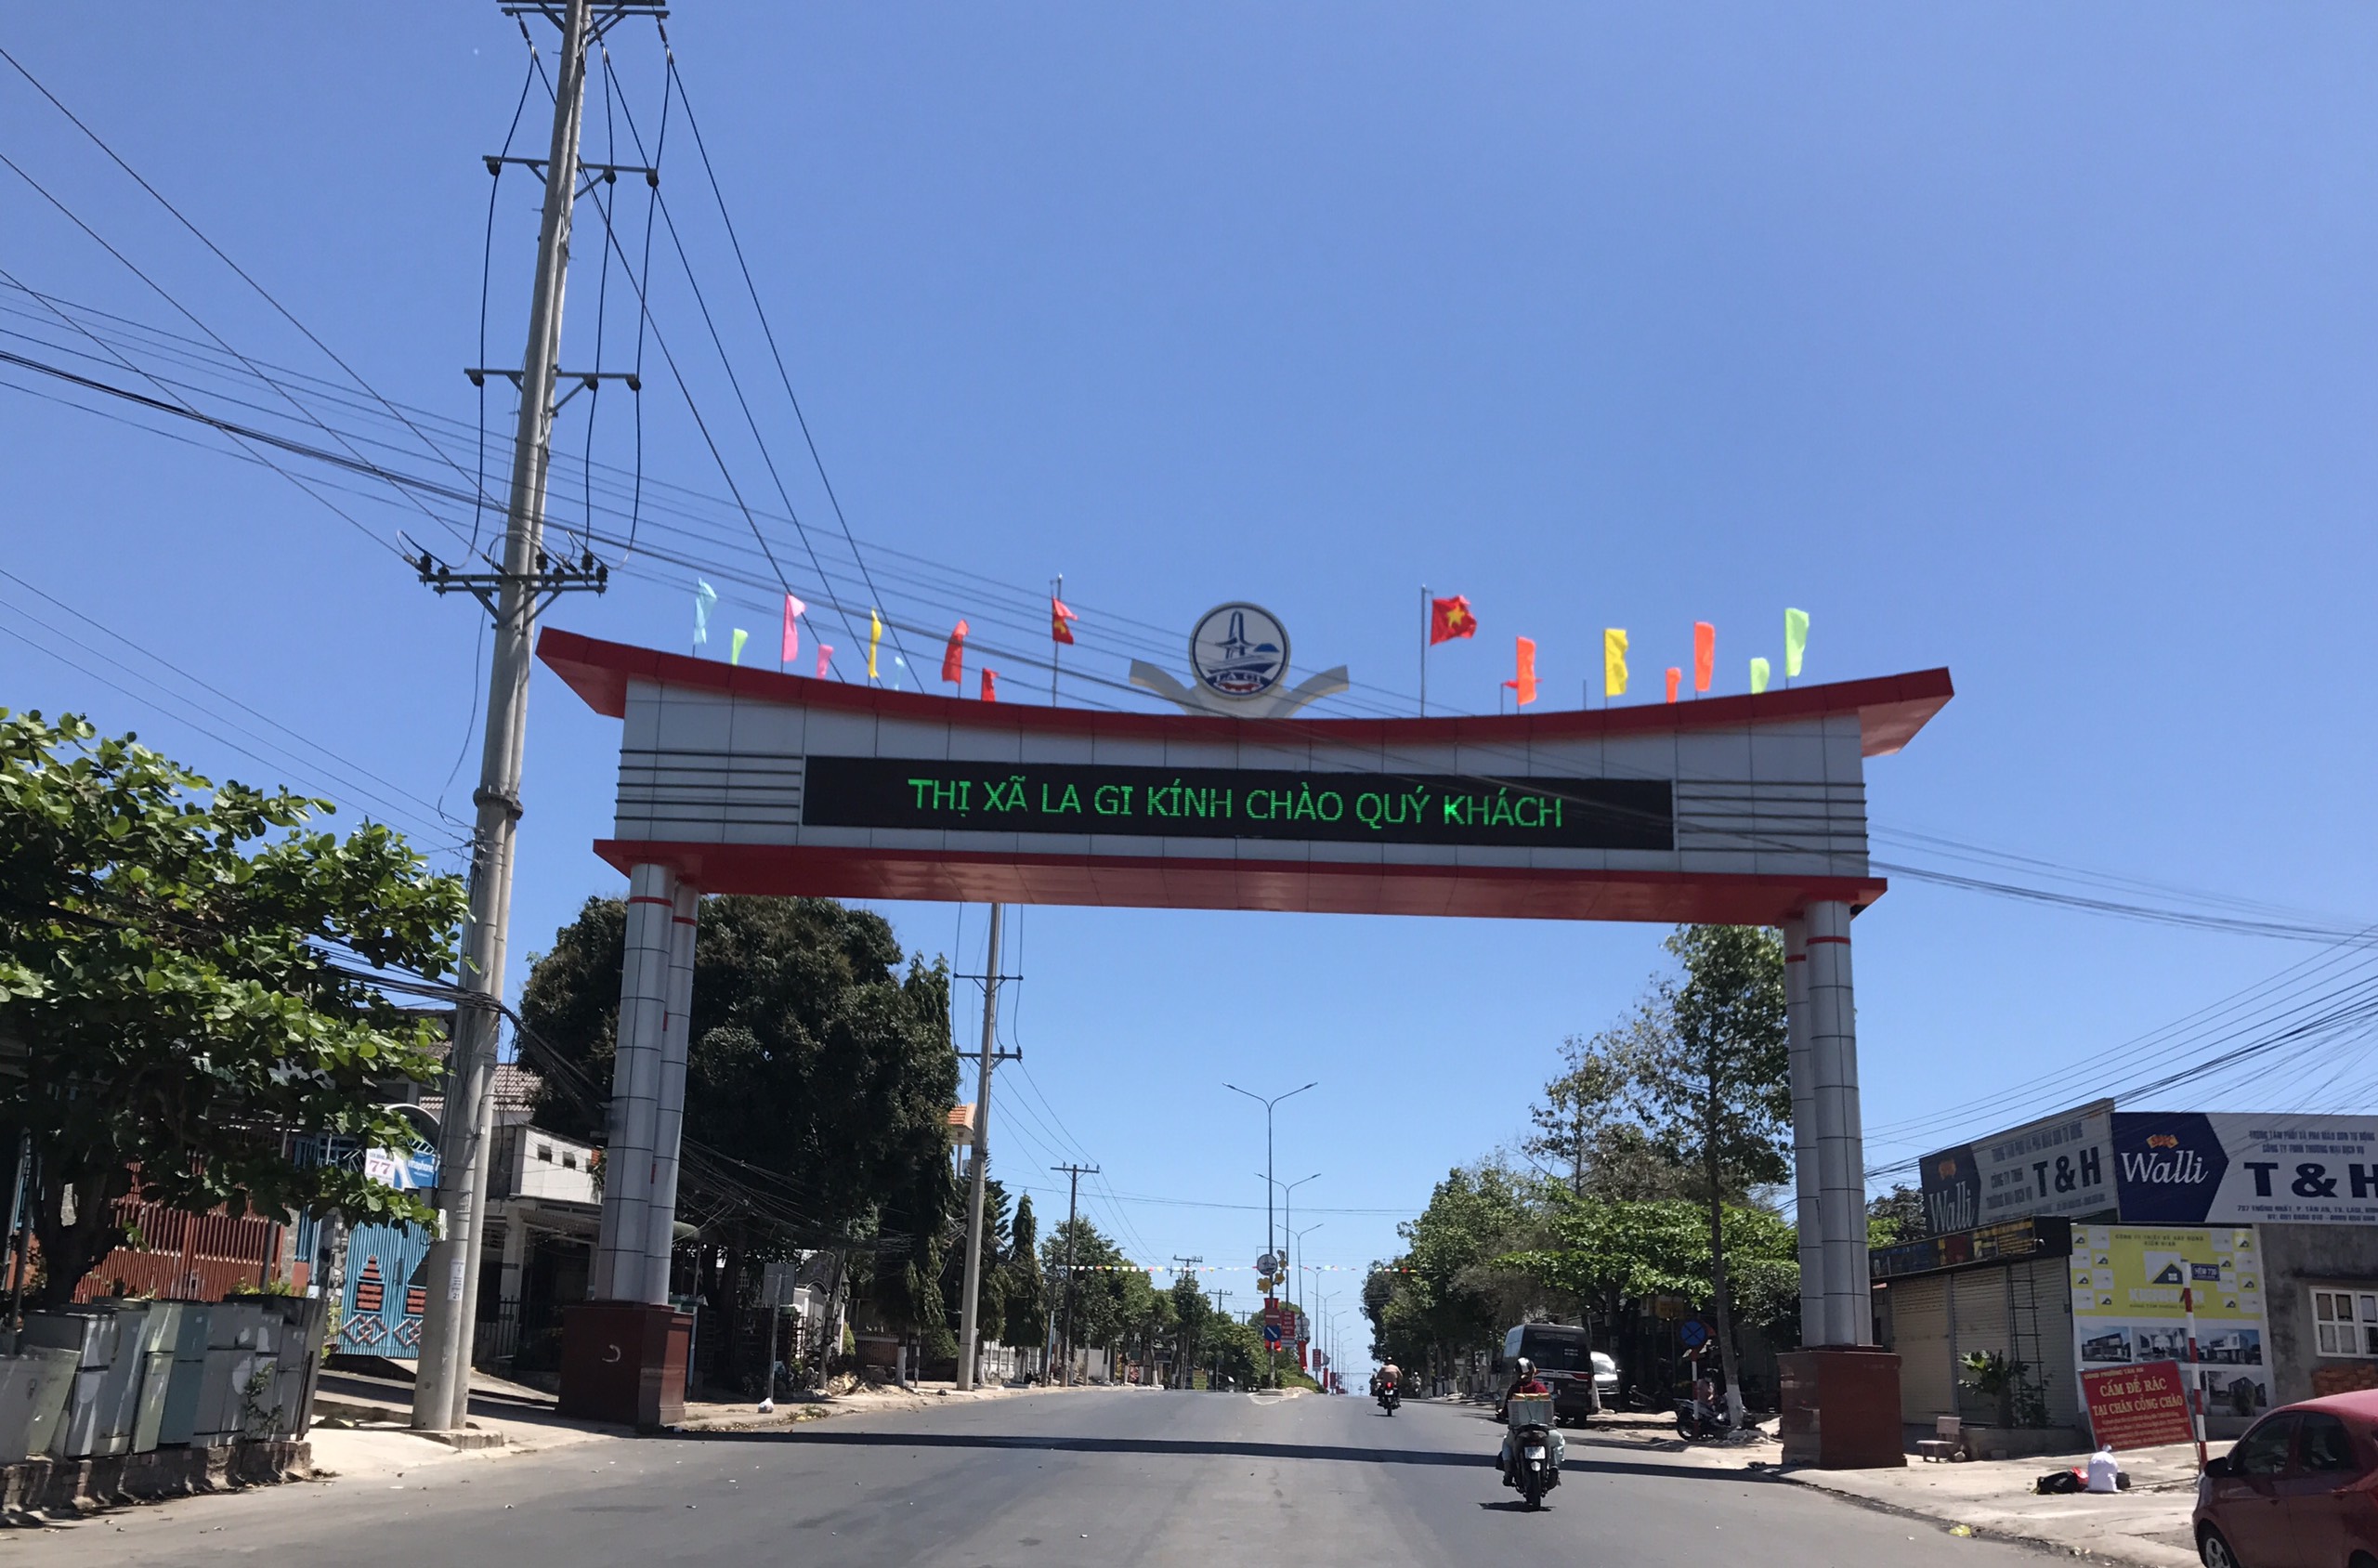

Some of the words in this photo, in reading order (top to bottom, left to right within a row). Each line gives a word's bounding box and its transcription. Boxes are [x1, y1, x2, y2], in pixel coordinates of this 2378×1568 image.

[908, 778, 972, 817] THỊ
[983, 775, 1028, 812] XÃ
[1042, 783, 1081, 814] LA
[1094, 785, 1133, 816] GI
[1147, 778, 1232, 818] KÍNH
[1246, 782, 1343, 821] CHÀO
[1356, 785, 1431, 830] QUÝ
[1444, 787, 1562, 828] KHÁCH
[369, 1159, 391, 1175] 77
[2121, 1150, 2209, 1184] Walli
[1928, 1181, 1976, 1233] Walli
[2100, 1379, 2124, 1397] CẤM
[2144, 1376, 2168, 1392] RÁC
[2092, 1404, 2108, 1418] TẠI
